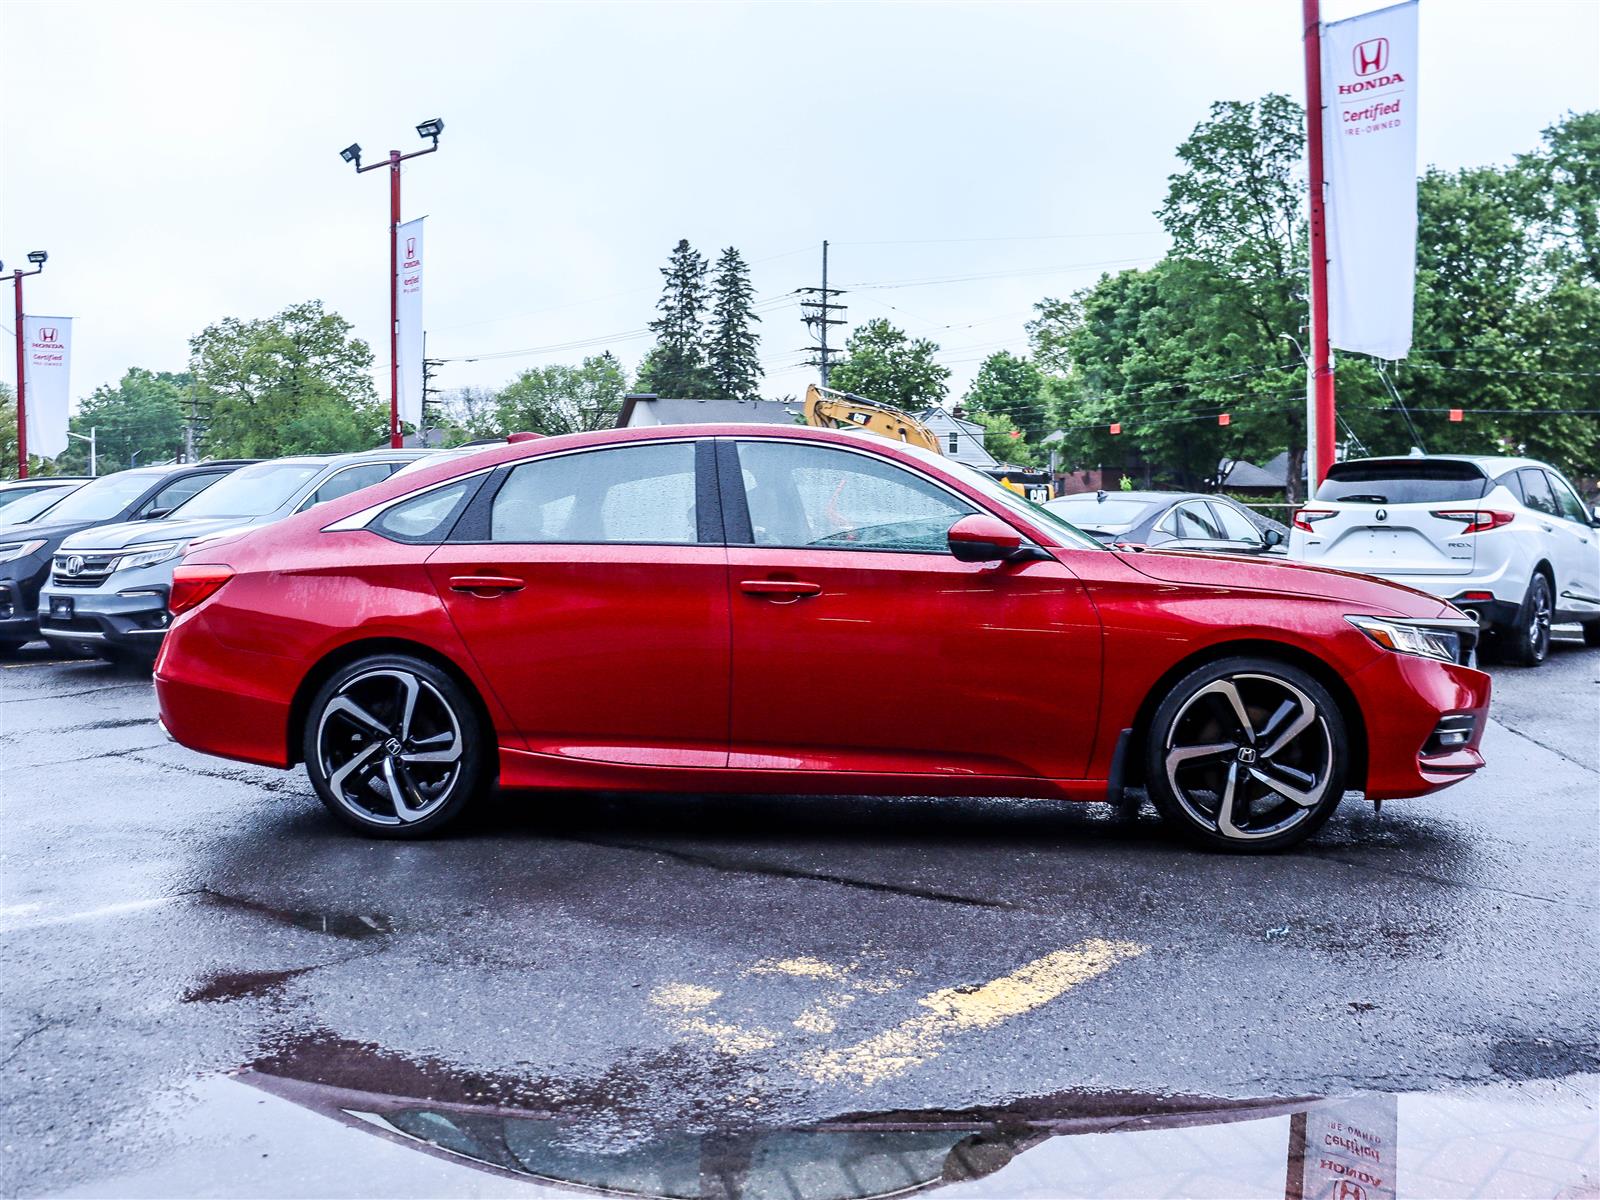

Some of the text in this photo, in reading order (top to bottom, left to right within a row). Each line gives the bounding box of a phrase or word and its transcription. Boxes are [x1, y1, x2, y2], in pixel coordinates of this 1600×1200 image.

[1338, 73, 1405, 95] HONDA
[1343, 99, 1401, 122] Certified
[1344, 119, 1401, 136] RE-OWNED
[1030, 489, 1048, 505] CAT
